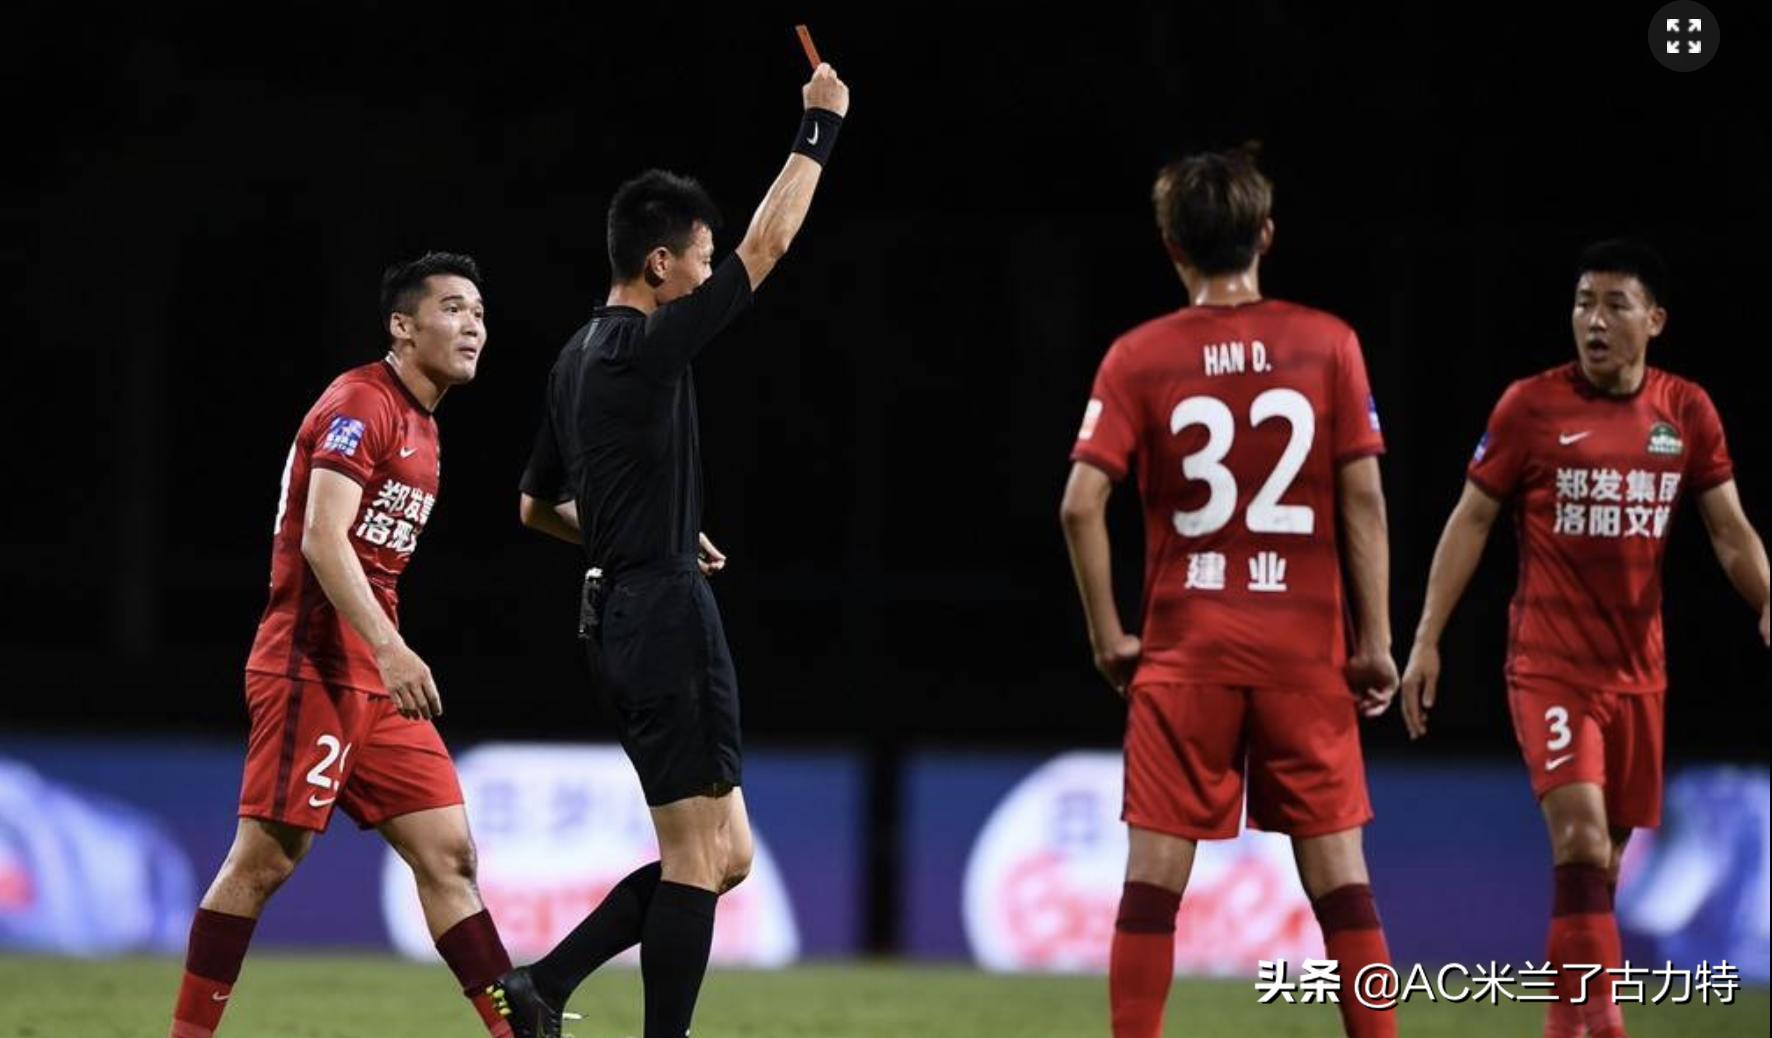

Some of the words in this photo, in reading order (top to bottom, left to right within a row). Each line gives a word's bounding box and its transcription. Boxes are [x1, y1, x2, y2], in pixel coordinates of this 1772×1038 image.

[1203, 341, 1246, 376] HAN
[1251, 339, 1272, 373] D.
[1169, 388, 1316, 537] 32
[1184, 550, 1288, 592] 建业
[1544, 706, 1573, 752] 3
